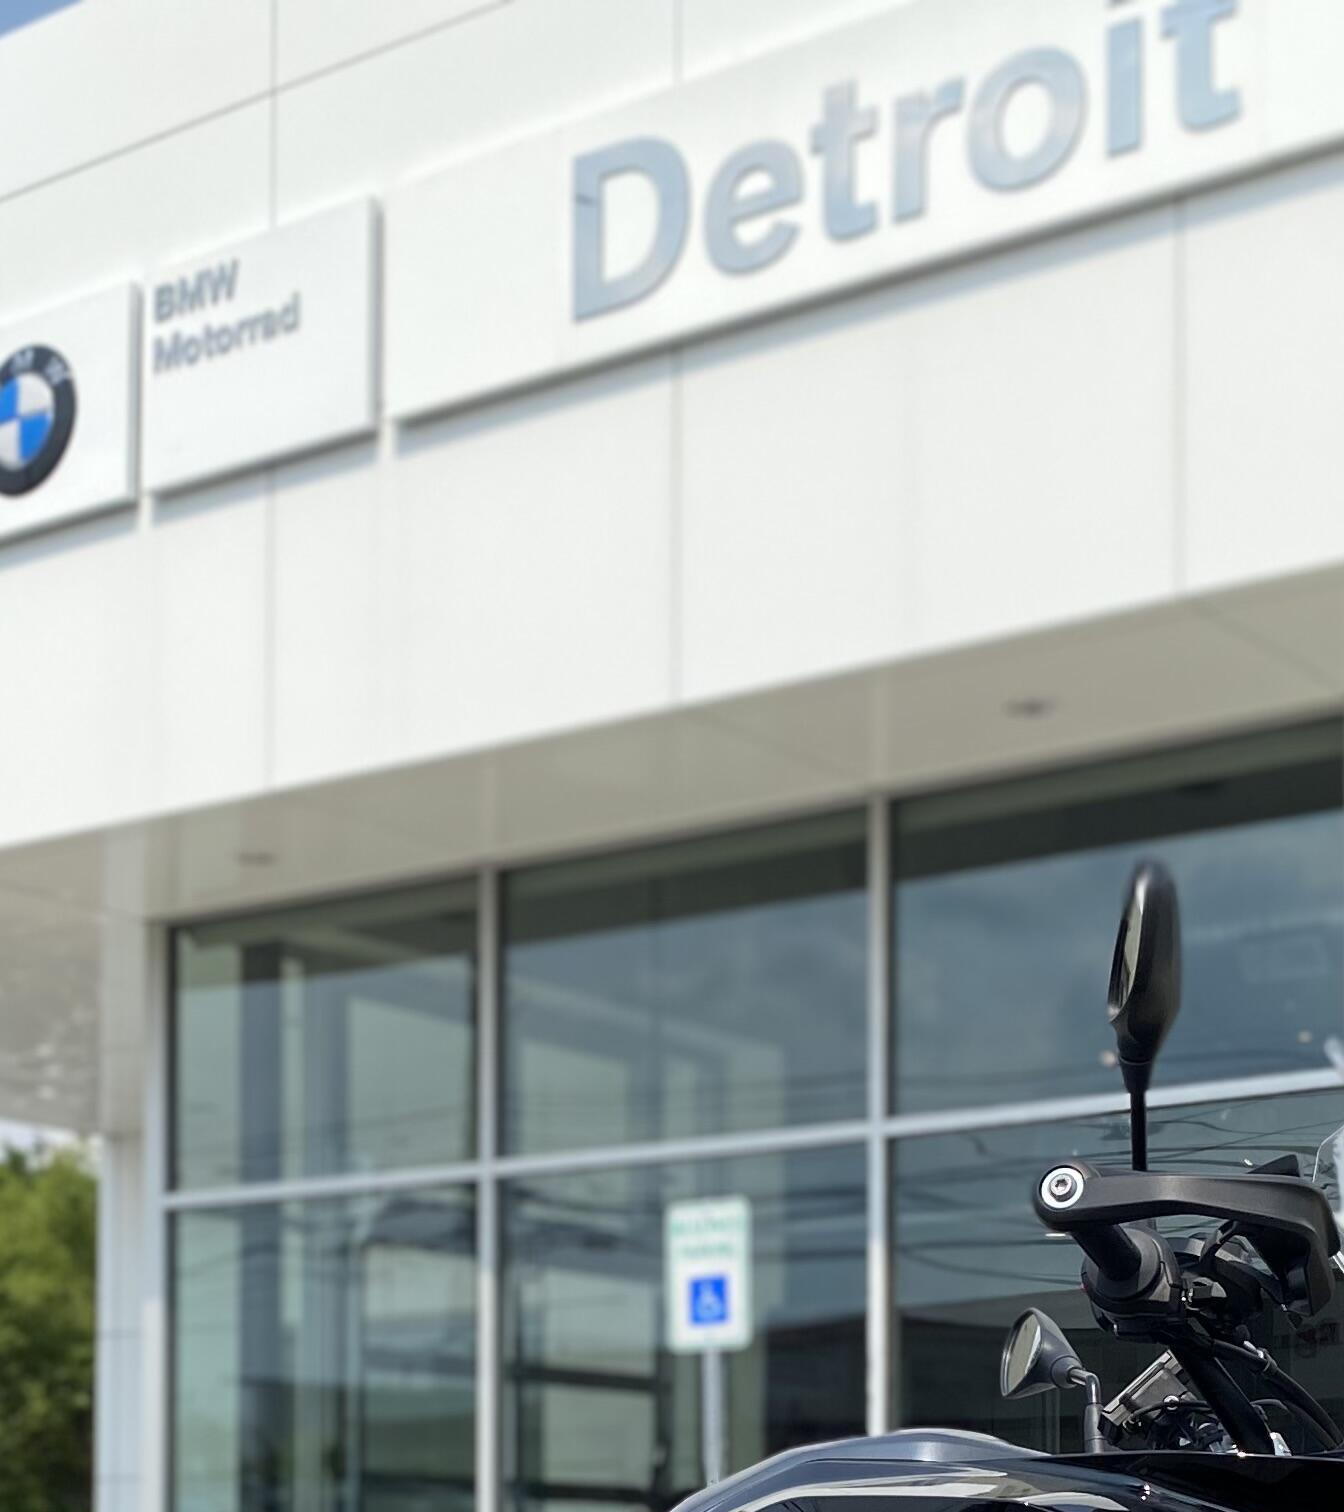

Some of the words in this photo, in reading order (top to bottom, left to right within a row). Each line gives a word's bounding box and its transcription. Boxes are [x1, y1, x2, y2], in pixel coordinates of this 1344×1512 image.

[571, 0, 1242, 324] Detroit
[153, 290, 302, 375] Motorrad
[154, 257, 240, 324] BMW
